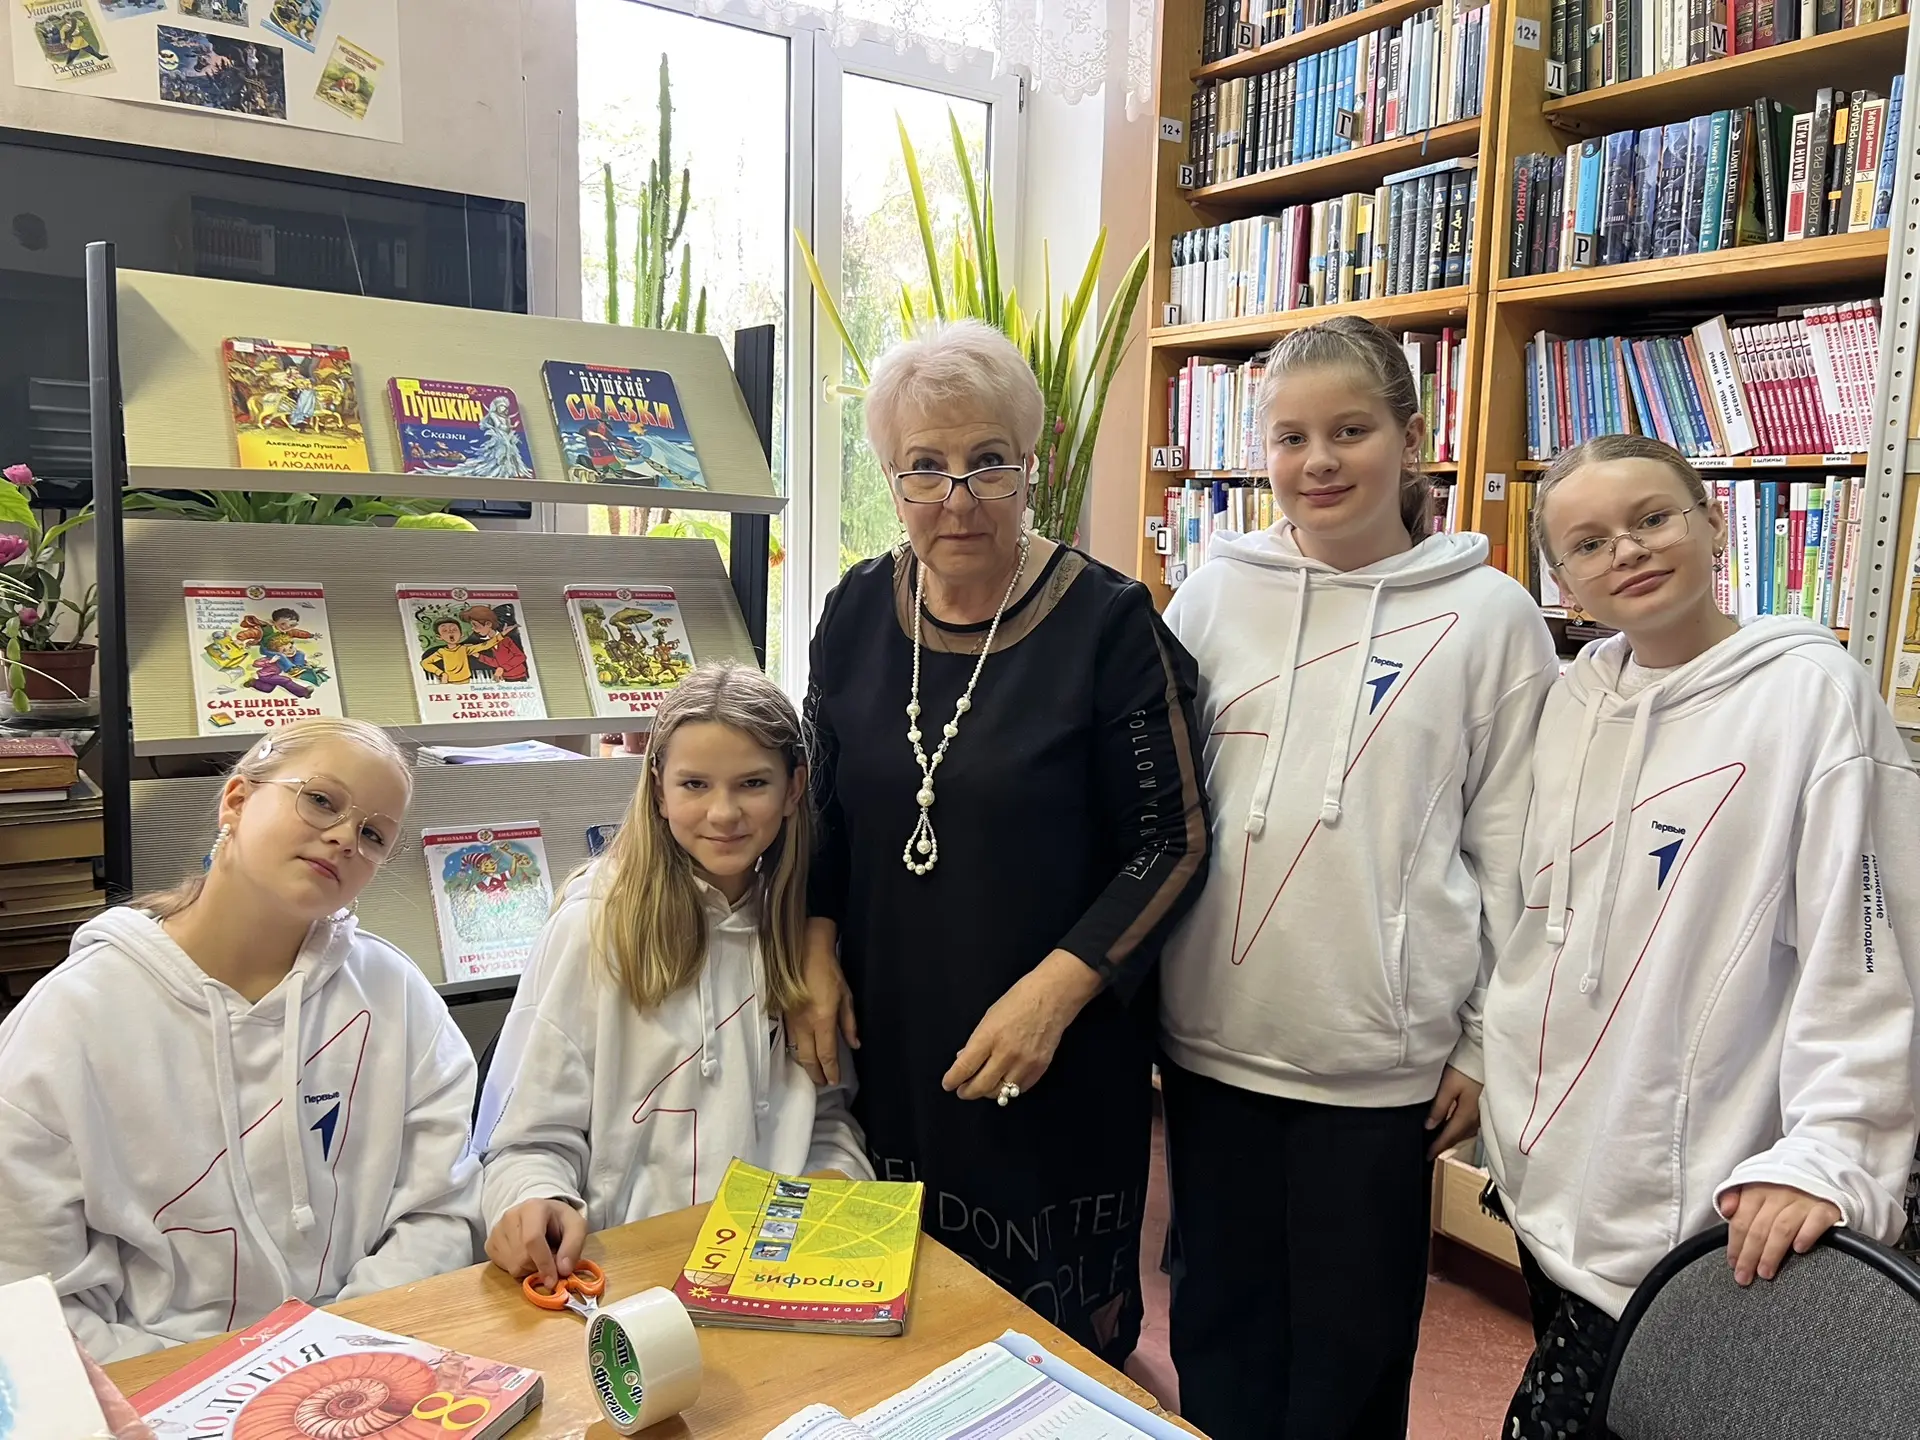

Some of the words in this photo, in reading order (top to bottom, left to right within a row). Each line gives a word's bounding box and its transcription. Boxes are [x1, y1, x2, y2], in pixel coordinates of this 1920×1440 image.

[1239, 26, 1251, 45] Б
[1517, 25, 1538, 41] 12+
[1712, 25, 1727, 53] М
[1548, 66, 1562, 90] Л
[1340, 114, 1351, 134] Г
[1850, 97, 1862, 138] РЕМАРК
[1865, 110, 1877, 140] РЕМАРК
[1163, 123, 1181, 135] 12+
[1797, 123, 1809, 145] РИД
[1813, 146, 1825, 169] РИЗ
[1846, 139, 1855, 164] МАРИЯ
[1793, 148, 1806, 179] МАЙН
[1181, 167, 1193, 185] В
[1844, 166, 1853, 186] ЭРИХ
[1516, 167, 1528, 222] СУМЕРКИ
[1808, 173, 1822, 225] ДЖЕЙМС
[1576, 238, 1590, 263] Р
[1707, 351, 1720, 375] МИФЫ
[1718, 350, 1733, 379] ГРЕЦИИ
[418, 389, 470, 399] Александр
[579, 375, 647, 398] ПУШКИН
[565, 393, 675, 429] СКАЗКИ
[1717, 390, 1734, 425] ЛЕГЕНДЫ
[266, 440, 313, 449] Александр
[420, 429, 466, 441] Сказки
[284, 450, 333, 460] РУСЛАН
[1154, 449, 1166, 467] А
[1171, 449, 1182, 467] Б
[282, 460, 352, 471] ЛЮДМИЛА
[1488, 480, 1501, 493] 6+
[1370, 655, 1403, 669] Первые
[207, 698, 300, 710] СМЕШНЫЕ
[428, 693, 451, 701] ГДЕ
[456, 693, 478, 701] ЭТО
[461, 701, 484, 709] ГДЕ
[488, 701, 510, 709] ЭТО
[608, 690, 669, 702] РОБИН
[1129, 709, 1157, 789] FOLLOW
[437, 834, 473, 842] ШКОЛЬНАЯ
[497, 829, 538, 837] БИБЛИОТЕКА
[1651, 820, 1687, 835] Первые
[1861, 854, 1873, 891] детей
[1863, 894, 1872, 902] и
[1864, 906, 1875, 973] молодёжи
[304, 1091, 340, 1104] Первые
[716, 1228, 737, 1245] 6
[701, 1252, 727, 1270] 5
[754, 1272, 884, 1293] География
[710, 1296, 770, 1309] ЗВЕЗДА
[780, 1304, 863, 1313] ПОЛЯРНАЯ
[188, 1341, 326, 1440] ОЛОГИЯ
[412, 1391, 491, 1431] 8
